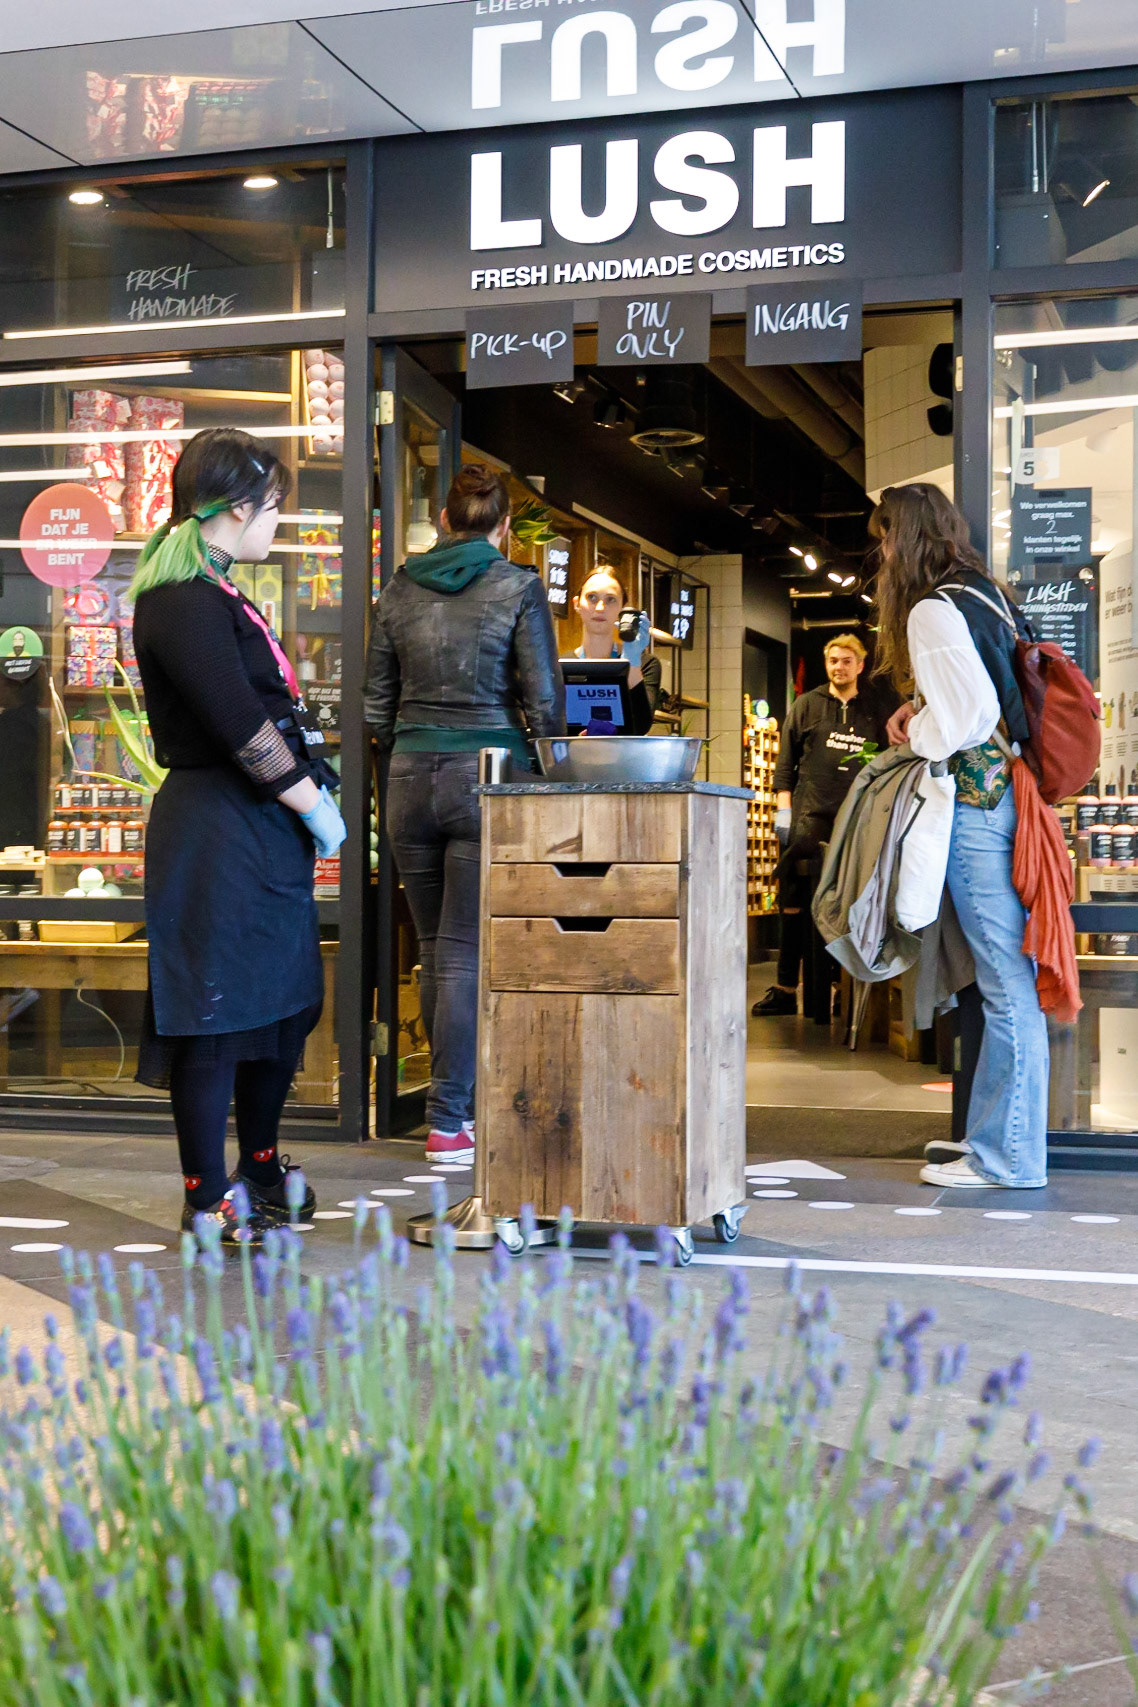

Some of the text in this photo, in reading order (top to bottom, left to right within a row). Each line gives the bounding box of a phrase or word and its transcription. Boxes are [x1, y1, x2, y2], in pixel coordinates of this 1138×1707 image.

[470, 120, 846, 251] LUSH
[125, 262, 200, 292] FRESH
[471, 243, 845, 290] FRESH HANDMADE COSMETICS
[127, 293, 240, 322] HANDMADE
[626, 301, 672, 330] PIN
[754, 300, 852, 337] INGANG
[615, 327, 685, 359] ONLY
[1022, 461, 1035, 476] 5
[49, 508, 80, 521] FIJN
[1045, 519, 1058, 534] 2
[41, 523, 89, 536] DAT JE
[47, 553, 84, 566] BENT
[1026, 581, 1076, 604] LUSH
[577, 689, 617, 697] LUSH
